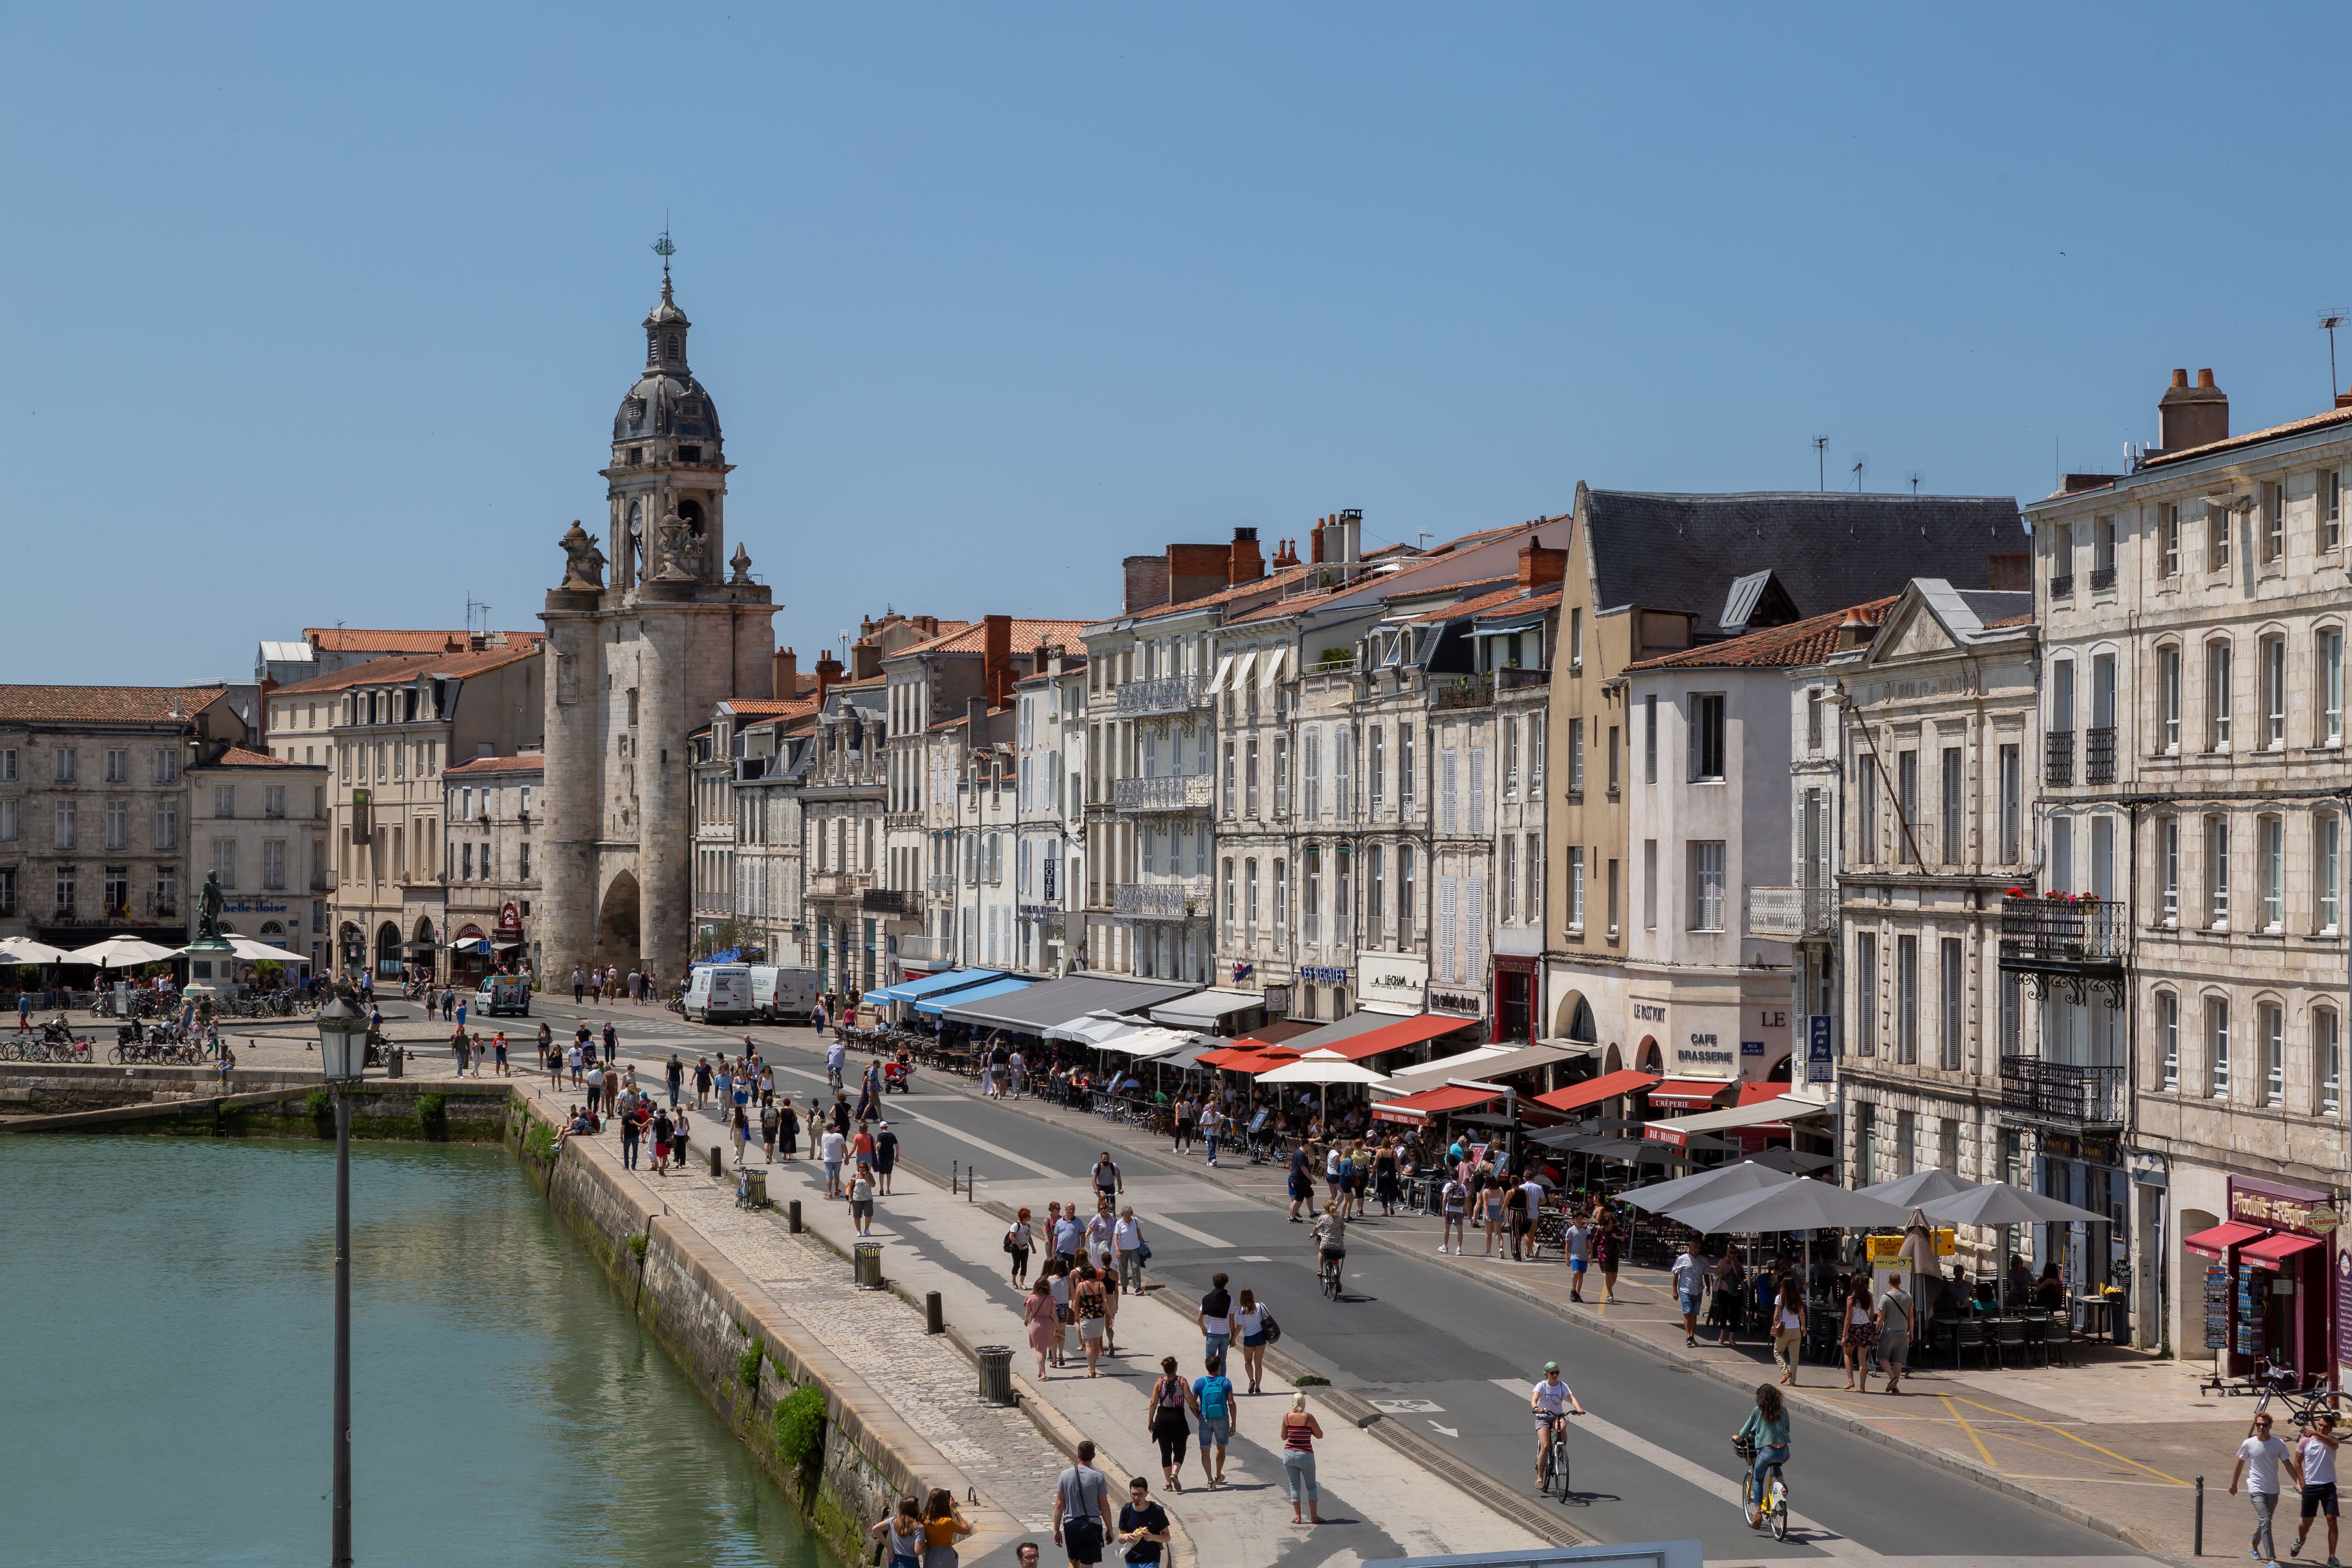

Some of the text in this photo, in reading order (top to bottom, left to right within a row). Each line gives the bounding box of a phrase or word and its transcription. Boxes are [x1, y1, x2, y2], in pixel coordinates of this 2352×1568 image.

[1045, 860, 1054, 900] HOTEL
[1300, 966, 1344, 982] LES REGATES
[514, 984, 520, 995] 3
[1430, 990, 1439, 1006] Les
[1460, 994, 1466, 1010] du
[1634, 1003, 1640, 1019] LE
[1761, 1011, 1786, 1027] LE
[1691, 1033, 1717, 1044] CAFE
[1814, 1030, 1828, 1038] poids
[1678, 1050, 1733, 1062] BRASSERIE
[1815, 1046, 1827, 1055] Roy
[1656, 1099, 1689, 1108] CRÊPERIE
[1660, 1131, 1681, 1144] BRASSERIE
[2233, 1191, 2271, 1219] Produits
[2308, 1216, 2313, 1226] la
